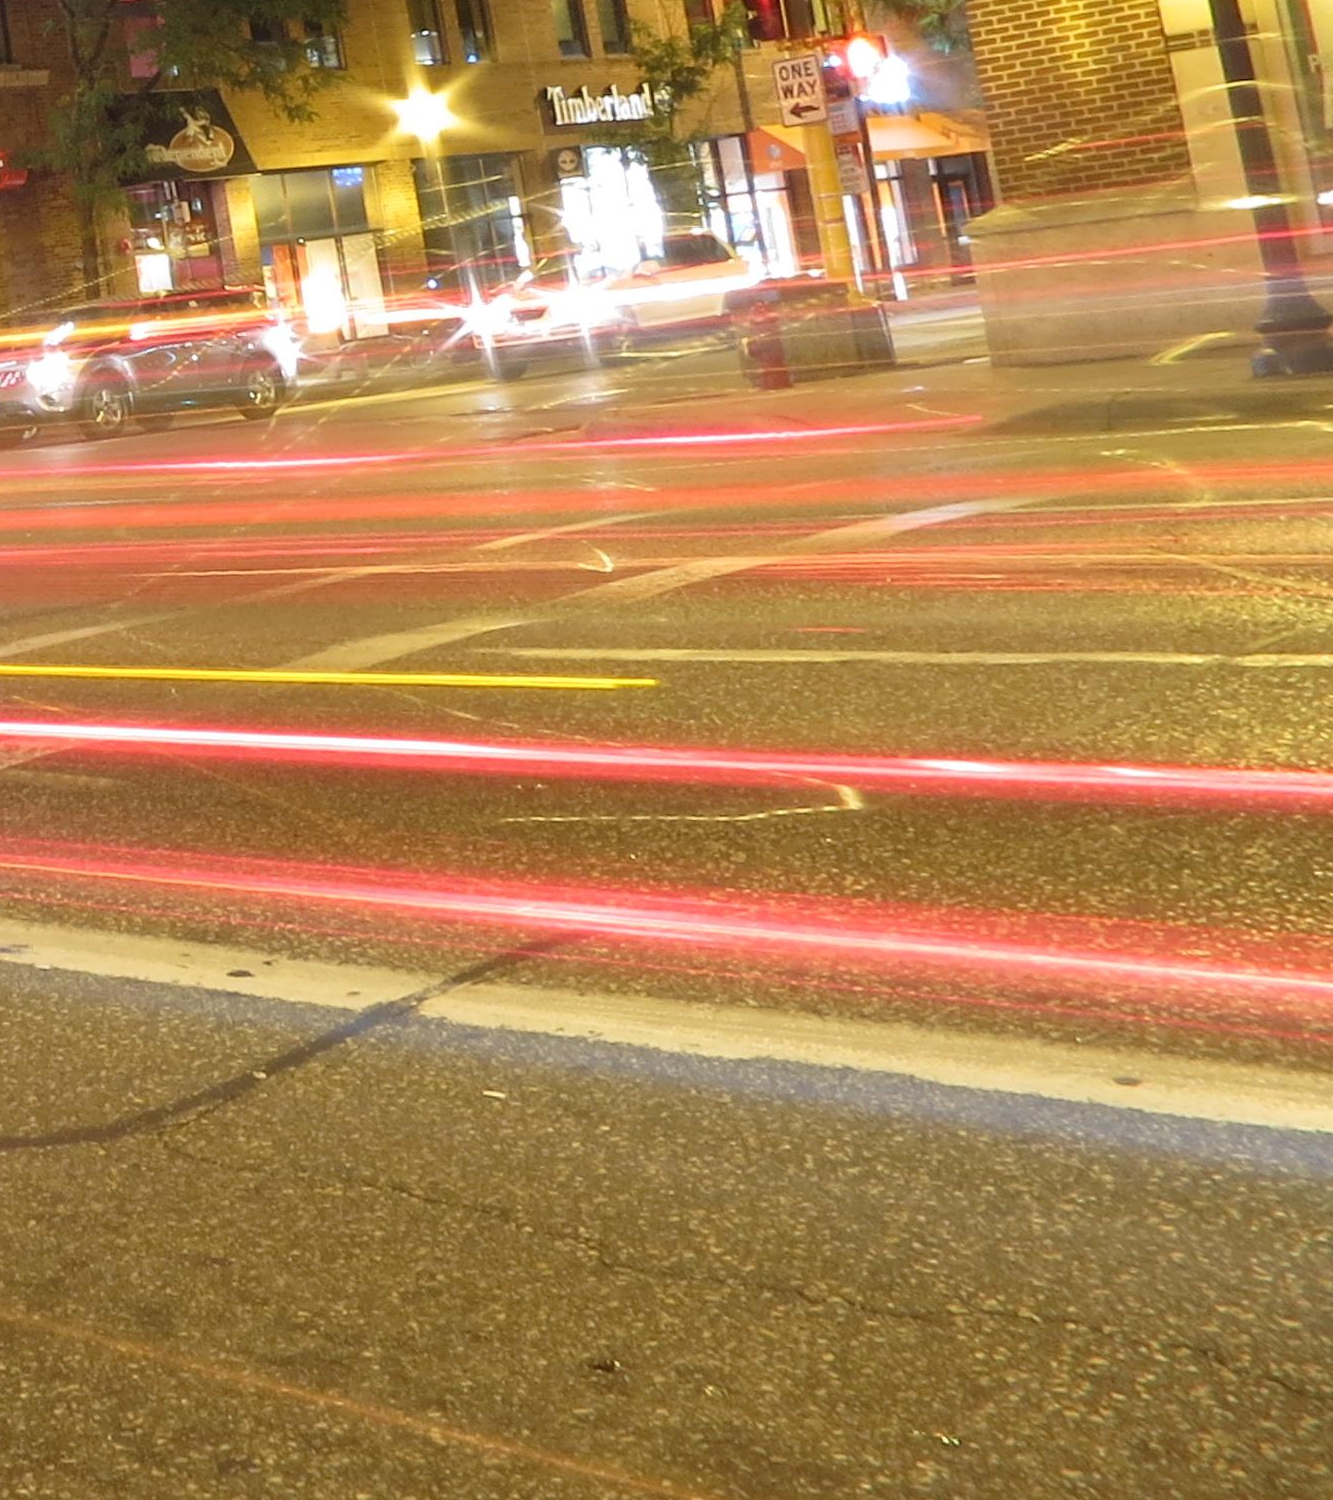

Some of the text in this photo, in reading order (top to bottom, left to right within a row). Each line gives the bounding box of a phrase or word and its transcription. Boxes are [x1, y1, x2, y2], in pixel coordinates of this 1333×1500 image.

[778, 61, 814, 82] ONE
[781, 80, 818, 100] WAY
[546, 82, 655, 126] Timberland
